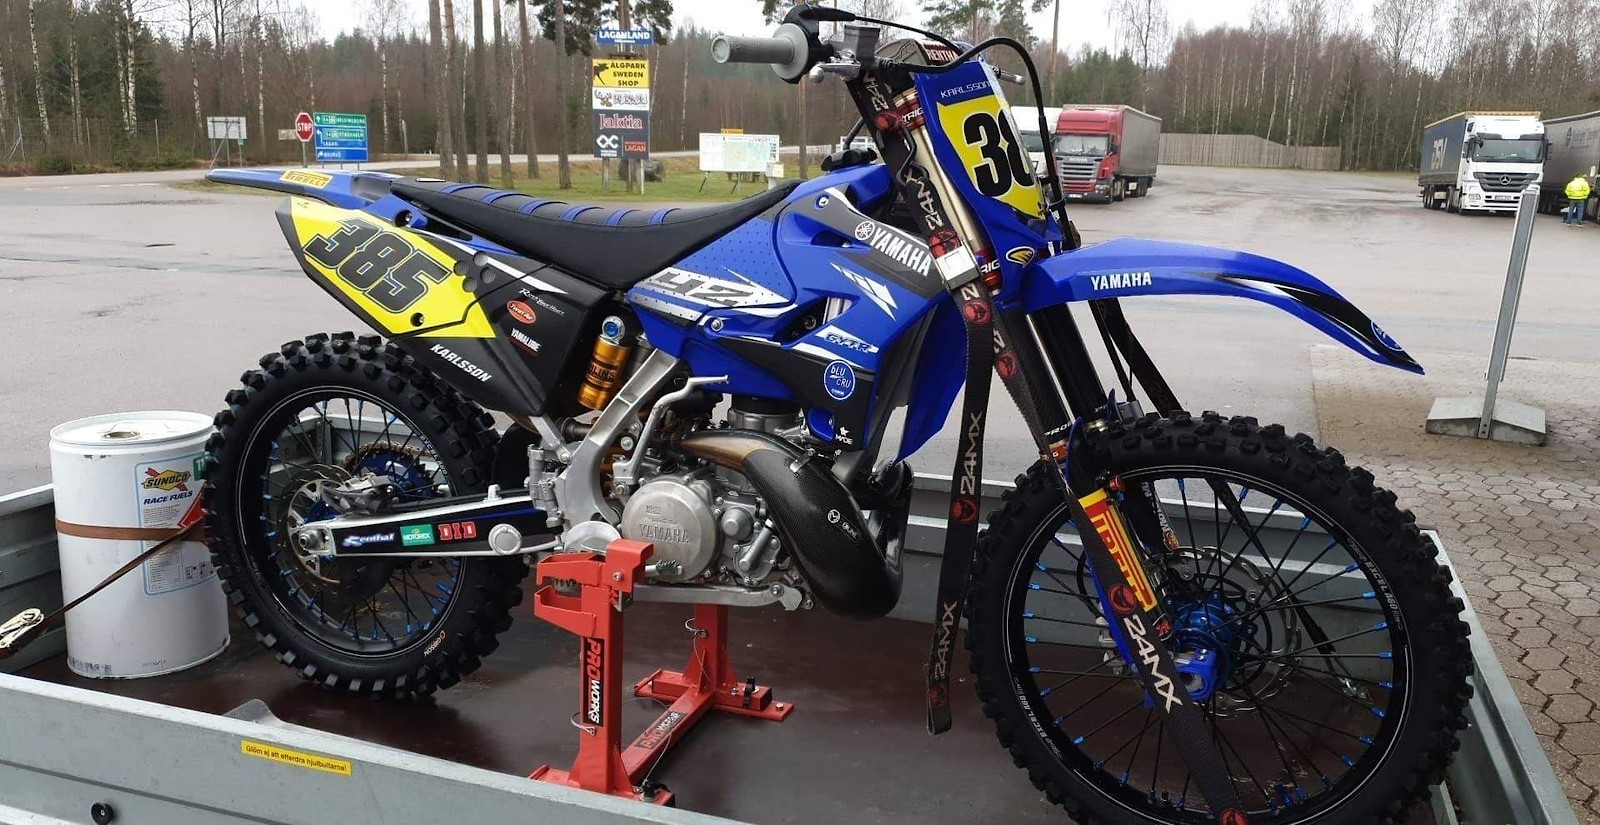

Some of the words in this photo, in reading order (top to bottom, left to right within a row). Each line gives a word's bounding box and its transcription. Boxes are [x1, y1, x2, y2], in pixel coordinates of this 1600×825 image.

[599, 31, 650, 39] LAGANLAND
[926, 48, 960, 61] RENTHA
[298, 122, 312, 132] STOP
[599, 113, 643, 130] Jaktia
[870, 227, 932, 277] YAMAHA
[303, 218, 452, 314] 385
[980, 259, 1001, 274] RIG
[1091, 272, 1152, 291] YAMAHA
[430, 343, 492, 382] KARLSSON
[960, 411, 982, 496] 24MX
[147, 473, 189, 487] SUNOCO
[143, 495, 168, 505] RACE
[169, 490, 193, 501] FUELS
[403, 533, 431, 541] MOTOREX
[438, 521, 477, 541] DID
[640, 523, 689, 543] YAMAHA
[1123, 614, 1183, 713] 24MX
[264, 750, 270, 758] ej
[281, 753, 305, 763] efterdra
